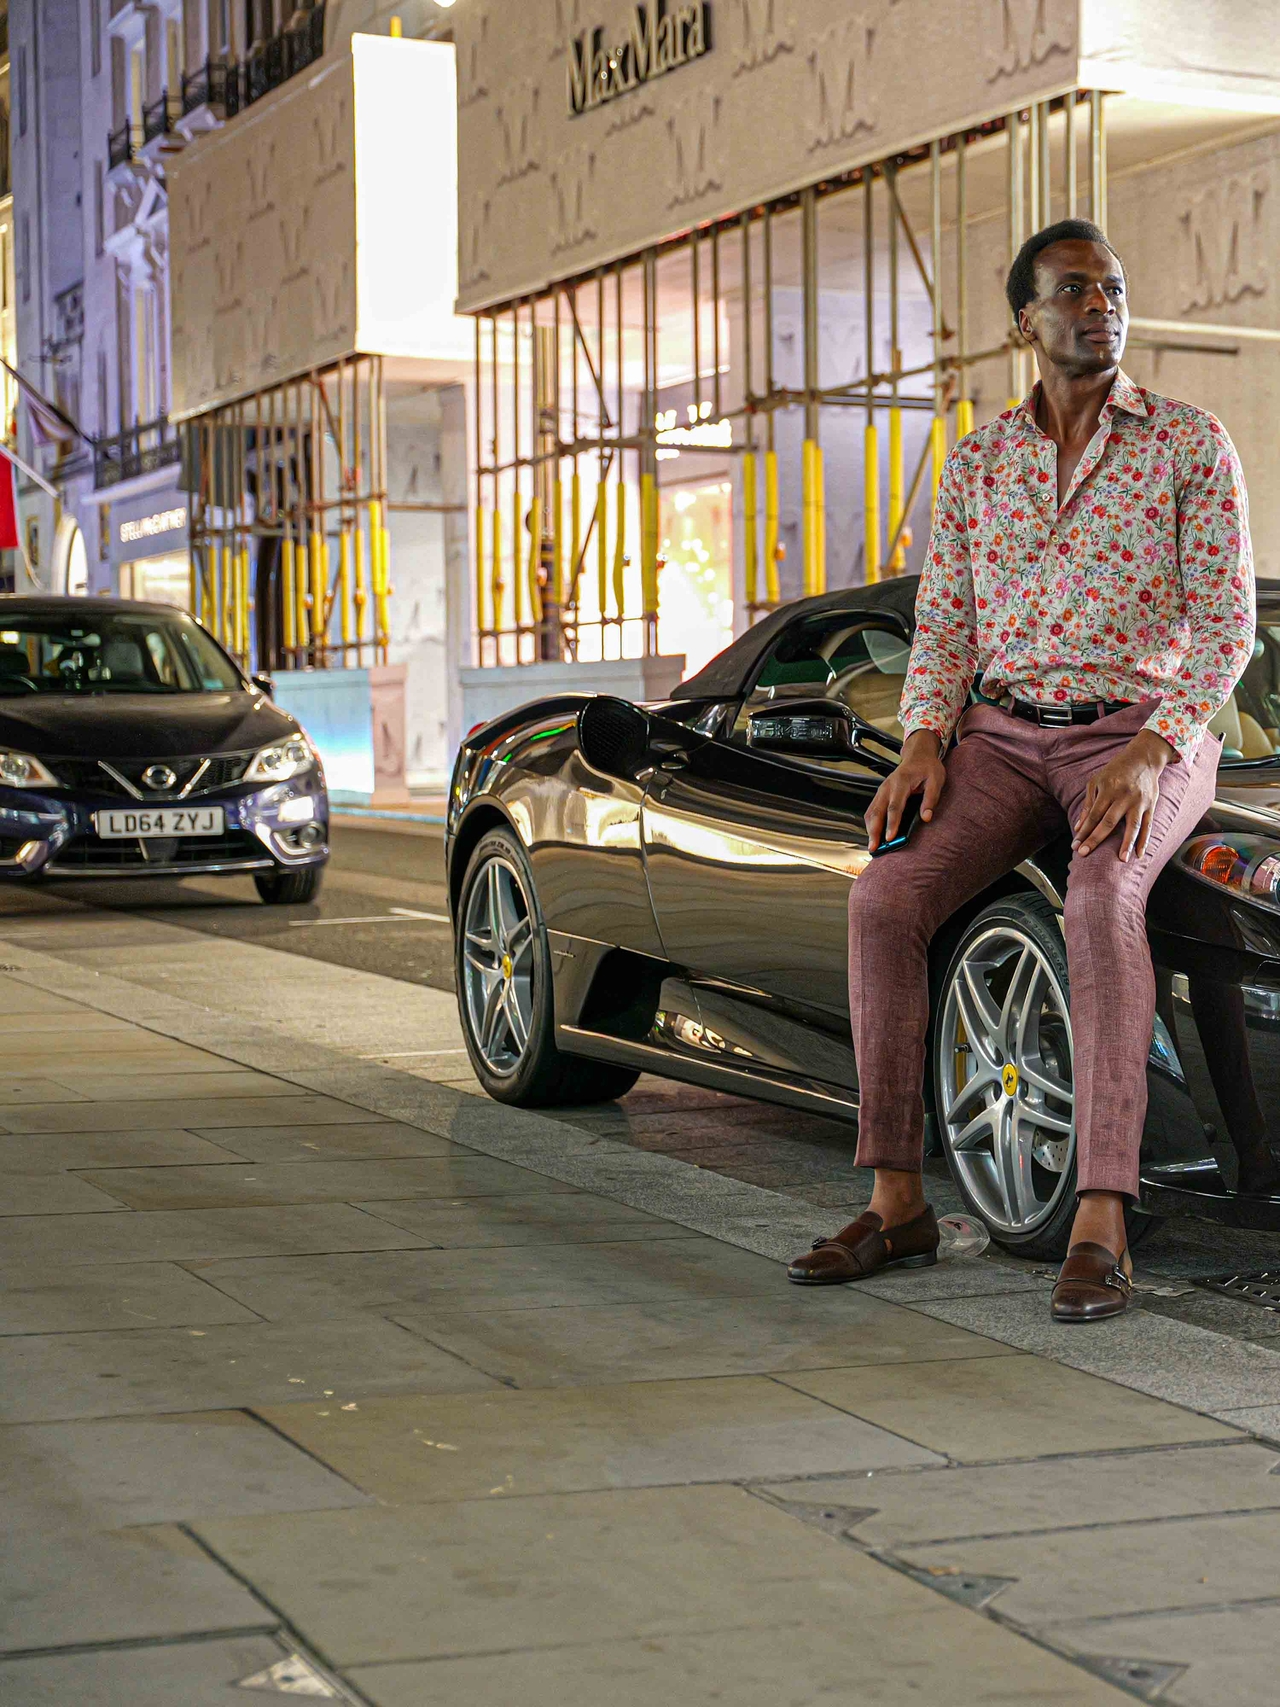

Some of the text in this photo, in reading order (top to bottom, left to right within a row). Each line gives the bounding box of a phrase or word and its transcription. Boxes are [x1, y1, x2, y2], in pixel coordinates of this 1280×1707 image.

[566, 0, 709, 119] MaxMara
[109, 811, 214, 834] LD64 ZYJ
